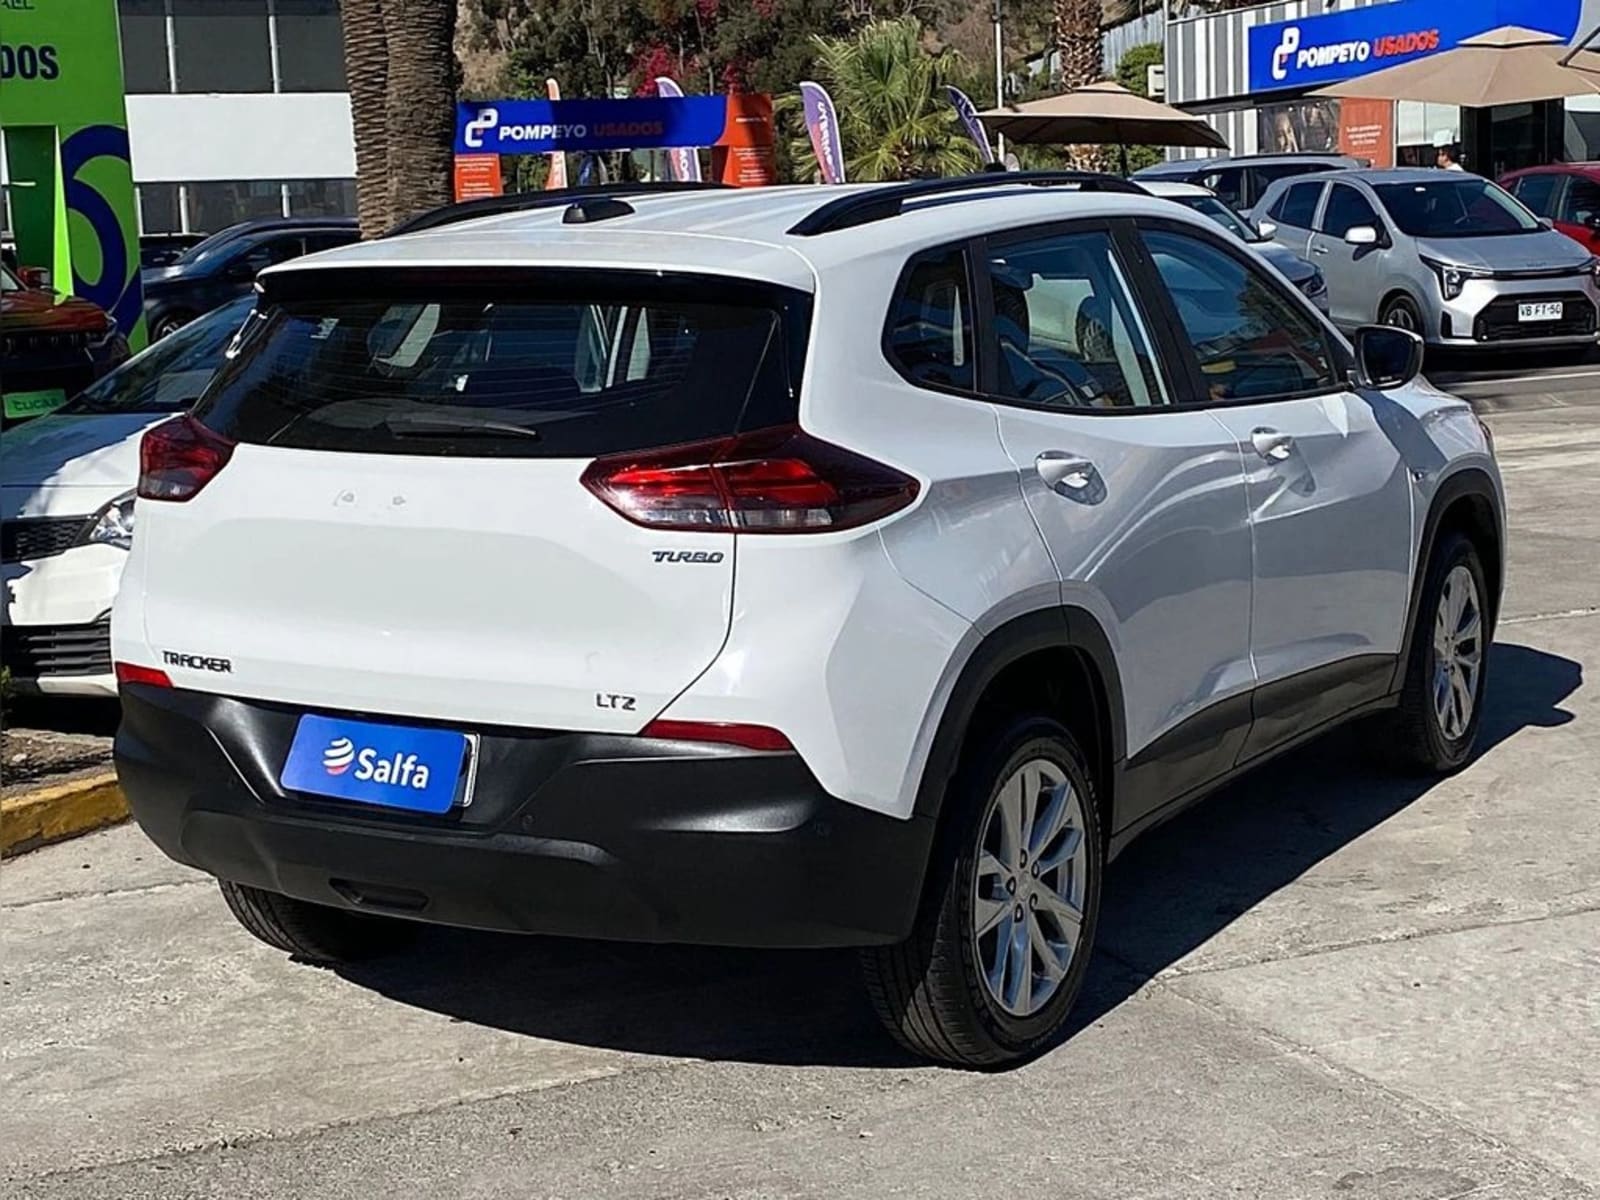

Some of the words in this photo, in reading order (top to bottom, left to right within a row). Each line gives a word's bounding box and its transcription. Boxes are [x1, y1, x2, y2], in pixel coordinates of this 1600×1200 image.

[1296, 41, 1371, 69] POMPEYO
[1372, 29, 1440, 57] USADOS
[499, 124, 587, 141] POMPEYO
[593, 121, 664, 137] USADOS
[651, 550, 724, 563] TURBO
[162, 650, 234, 674] TRACKER
[596, 692, 637, 711] LTZ
[354, 748, 430, 789] Salfa
